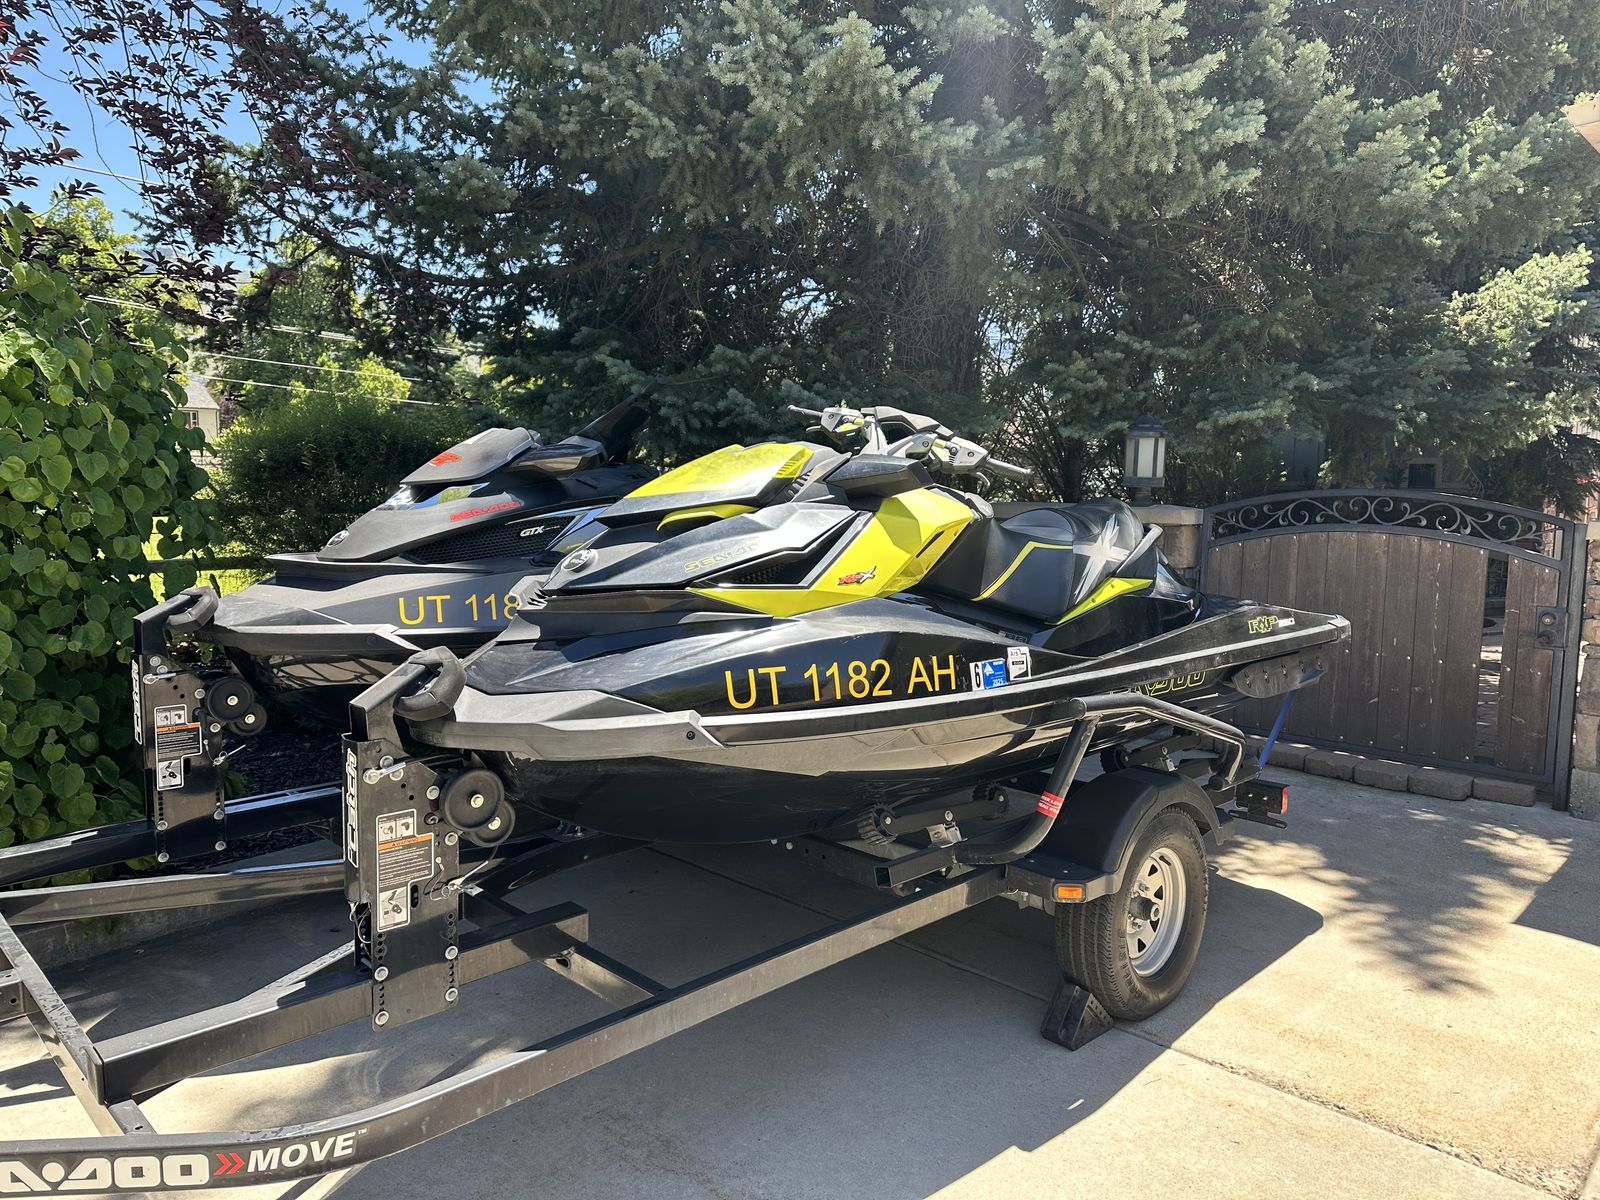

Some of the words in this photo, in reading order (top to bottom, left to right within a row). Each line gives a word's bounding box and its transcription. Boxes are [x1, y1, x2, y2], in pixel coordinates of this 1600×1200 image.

[520, 526, 545, 537] GTX
[398, 594, 451, 625] UT
[1248, 615, 1279, 634] RXP
[725, 666, 787, 709] UT
[803, 658, 893, 702] 1182
[907, 654, 956, 694] AH
[974, 662, 981, 688] 6
[247, 1131, 356, 1173] MOVE
